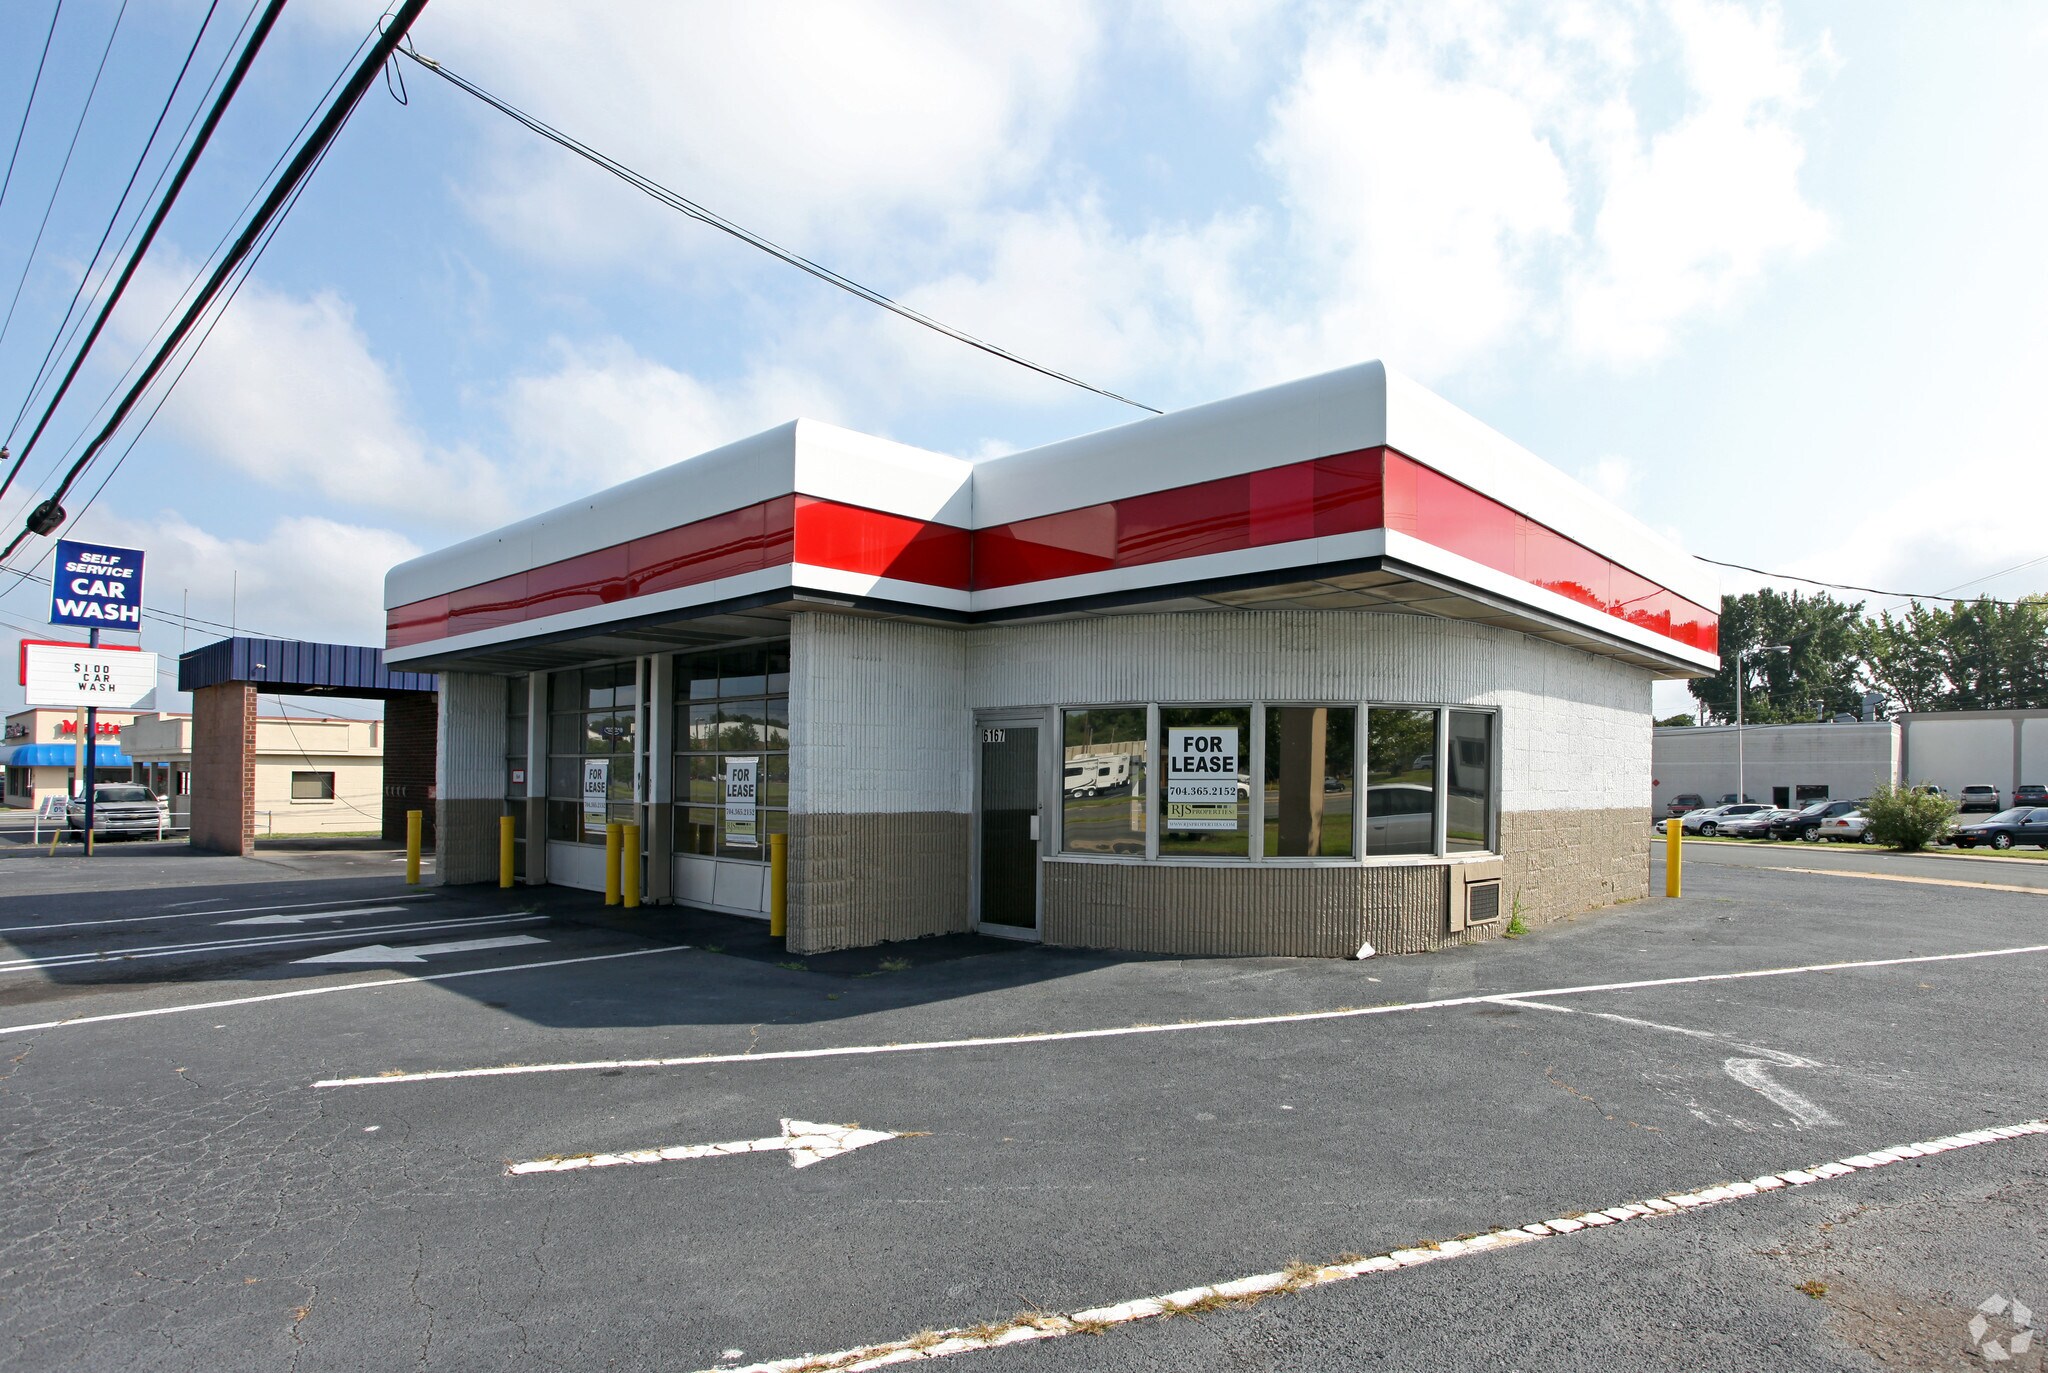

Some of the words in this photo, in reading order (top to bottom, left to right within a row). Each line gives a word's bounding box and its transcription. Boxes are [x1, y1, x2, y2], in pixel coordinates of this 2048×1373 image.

[80, 552, 121, 566] SELF
[65, 562, 133, 578] SERVICE
[71, 578, 125, 598] CAR
[55, 598, 139, 622] WASH
[83, 673, 110, 682] CAR
[78, 682, 115, 691] WASH
[984, 729, 1004, 742] 6167
[1184, 737, 1223, 752] FOR
[1172, 757, 1233, 772] LEASE
[589, 769, 602, 779] FOR
[732, 768, 750, 781] FOR
[585, 782, 605, 792] LEASE
[727, 784, 754, 797] LEASE
[1170, 787, 1236, 796] 704.365.2152
[1172, 804, 1192, 817] RJS
